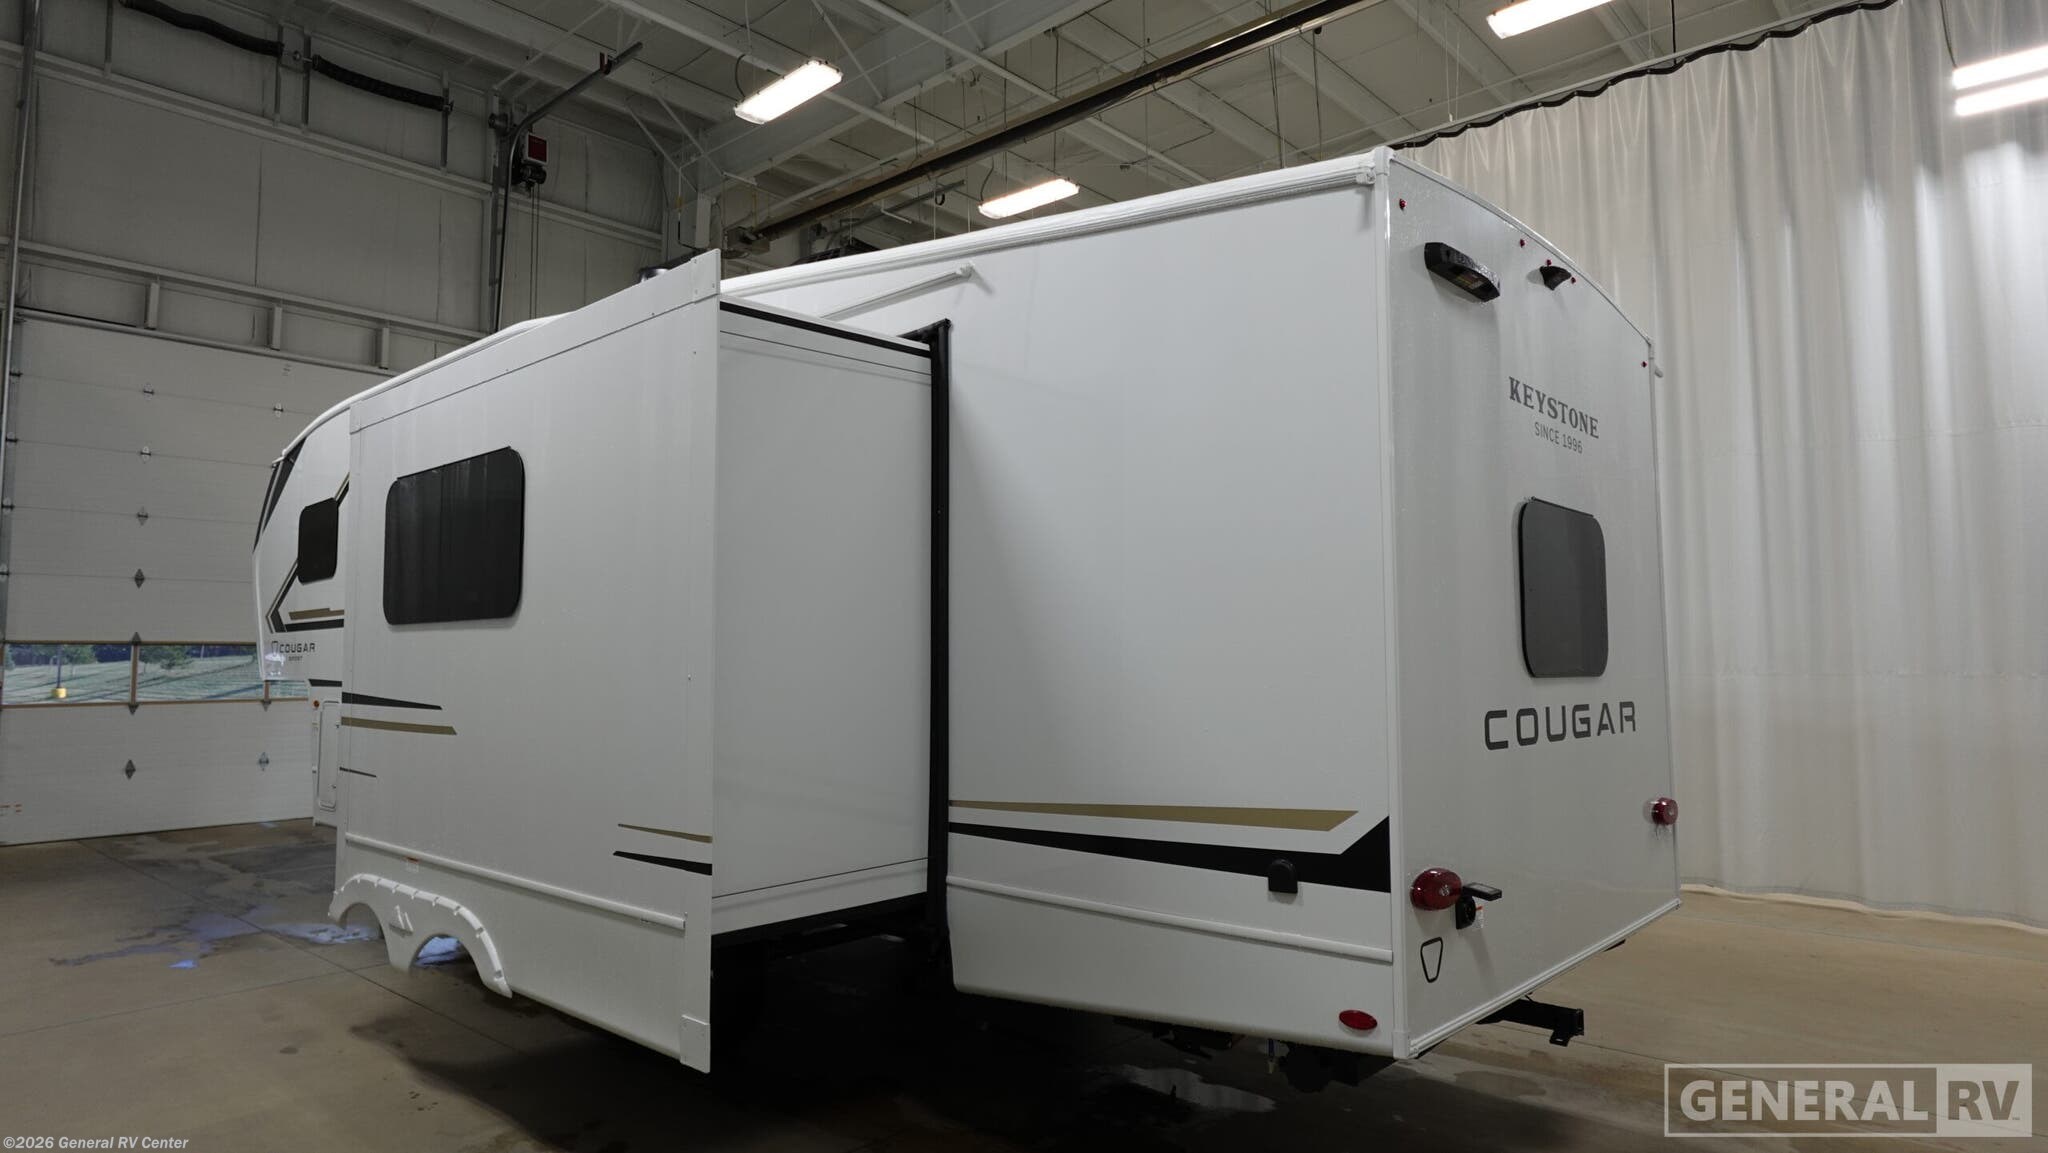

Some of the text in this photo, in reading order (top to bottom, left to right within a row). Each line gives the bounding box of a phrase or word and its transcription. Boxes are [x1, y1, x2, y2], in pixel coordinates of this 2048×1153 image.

[1509, 376, 1599, 439] KEYSTONE
[1535, 421, 1583, 454] SINCE 1996
[279, 642, 316, 653] COUGAR
[1485, 701, 1636, 750] COUGAR
